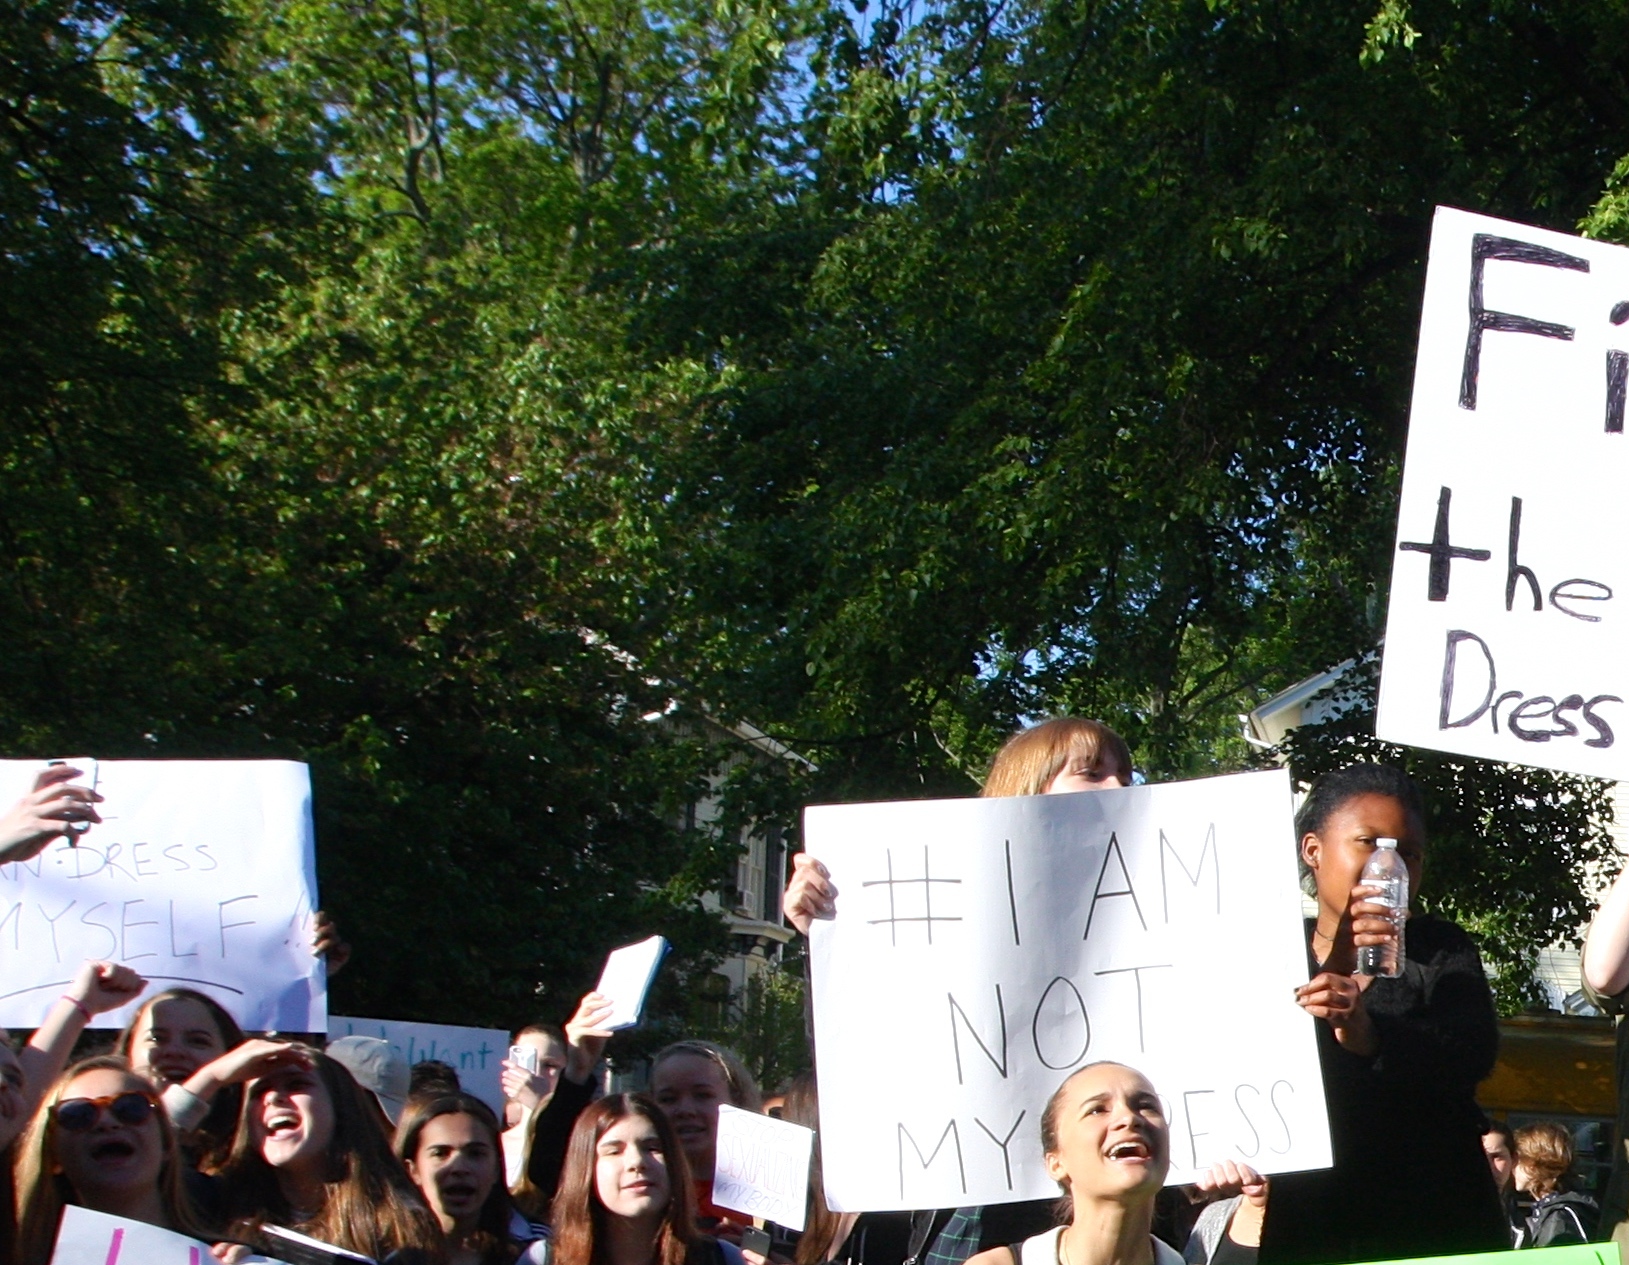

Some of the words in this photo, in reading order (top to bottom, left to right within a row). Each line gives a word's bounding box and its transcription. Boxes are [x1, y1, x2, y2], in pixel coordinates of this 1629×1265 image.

[1398, 485, 1614, 623] the
[1438, 628, 1625, 749] Dress
[1083, 821, 1221, 941] AM
[947, 963, 1173, 1086] NOT
[897, 1108, 1027, 1201] MY
